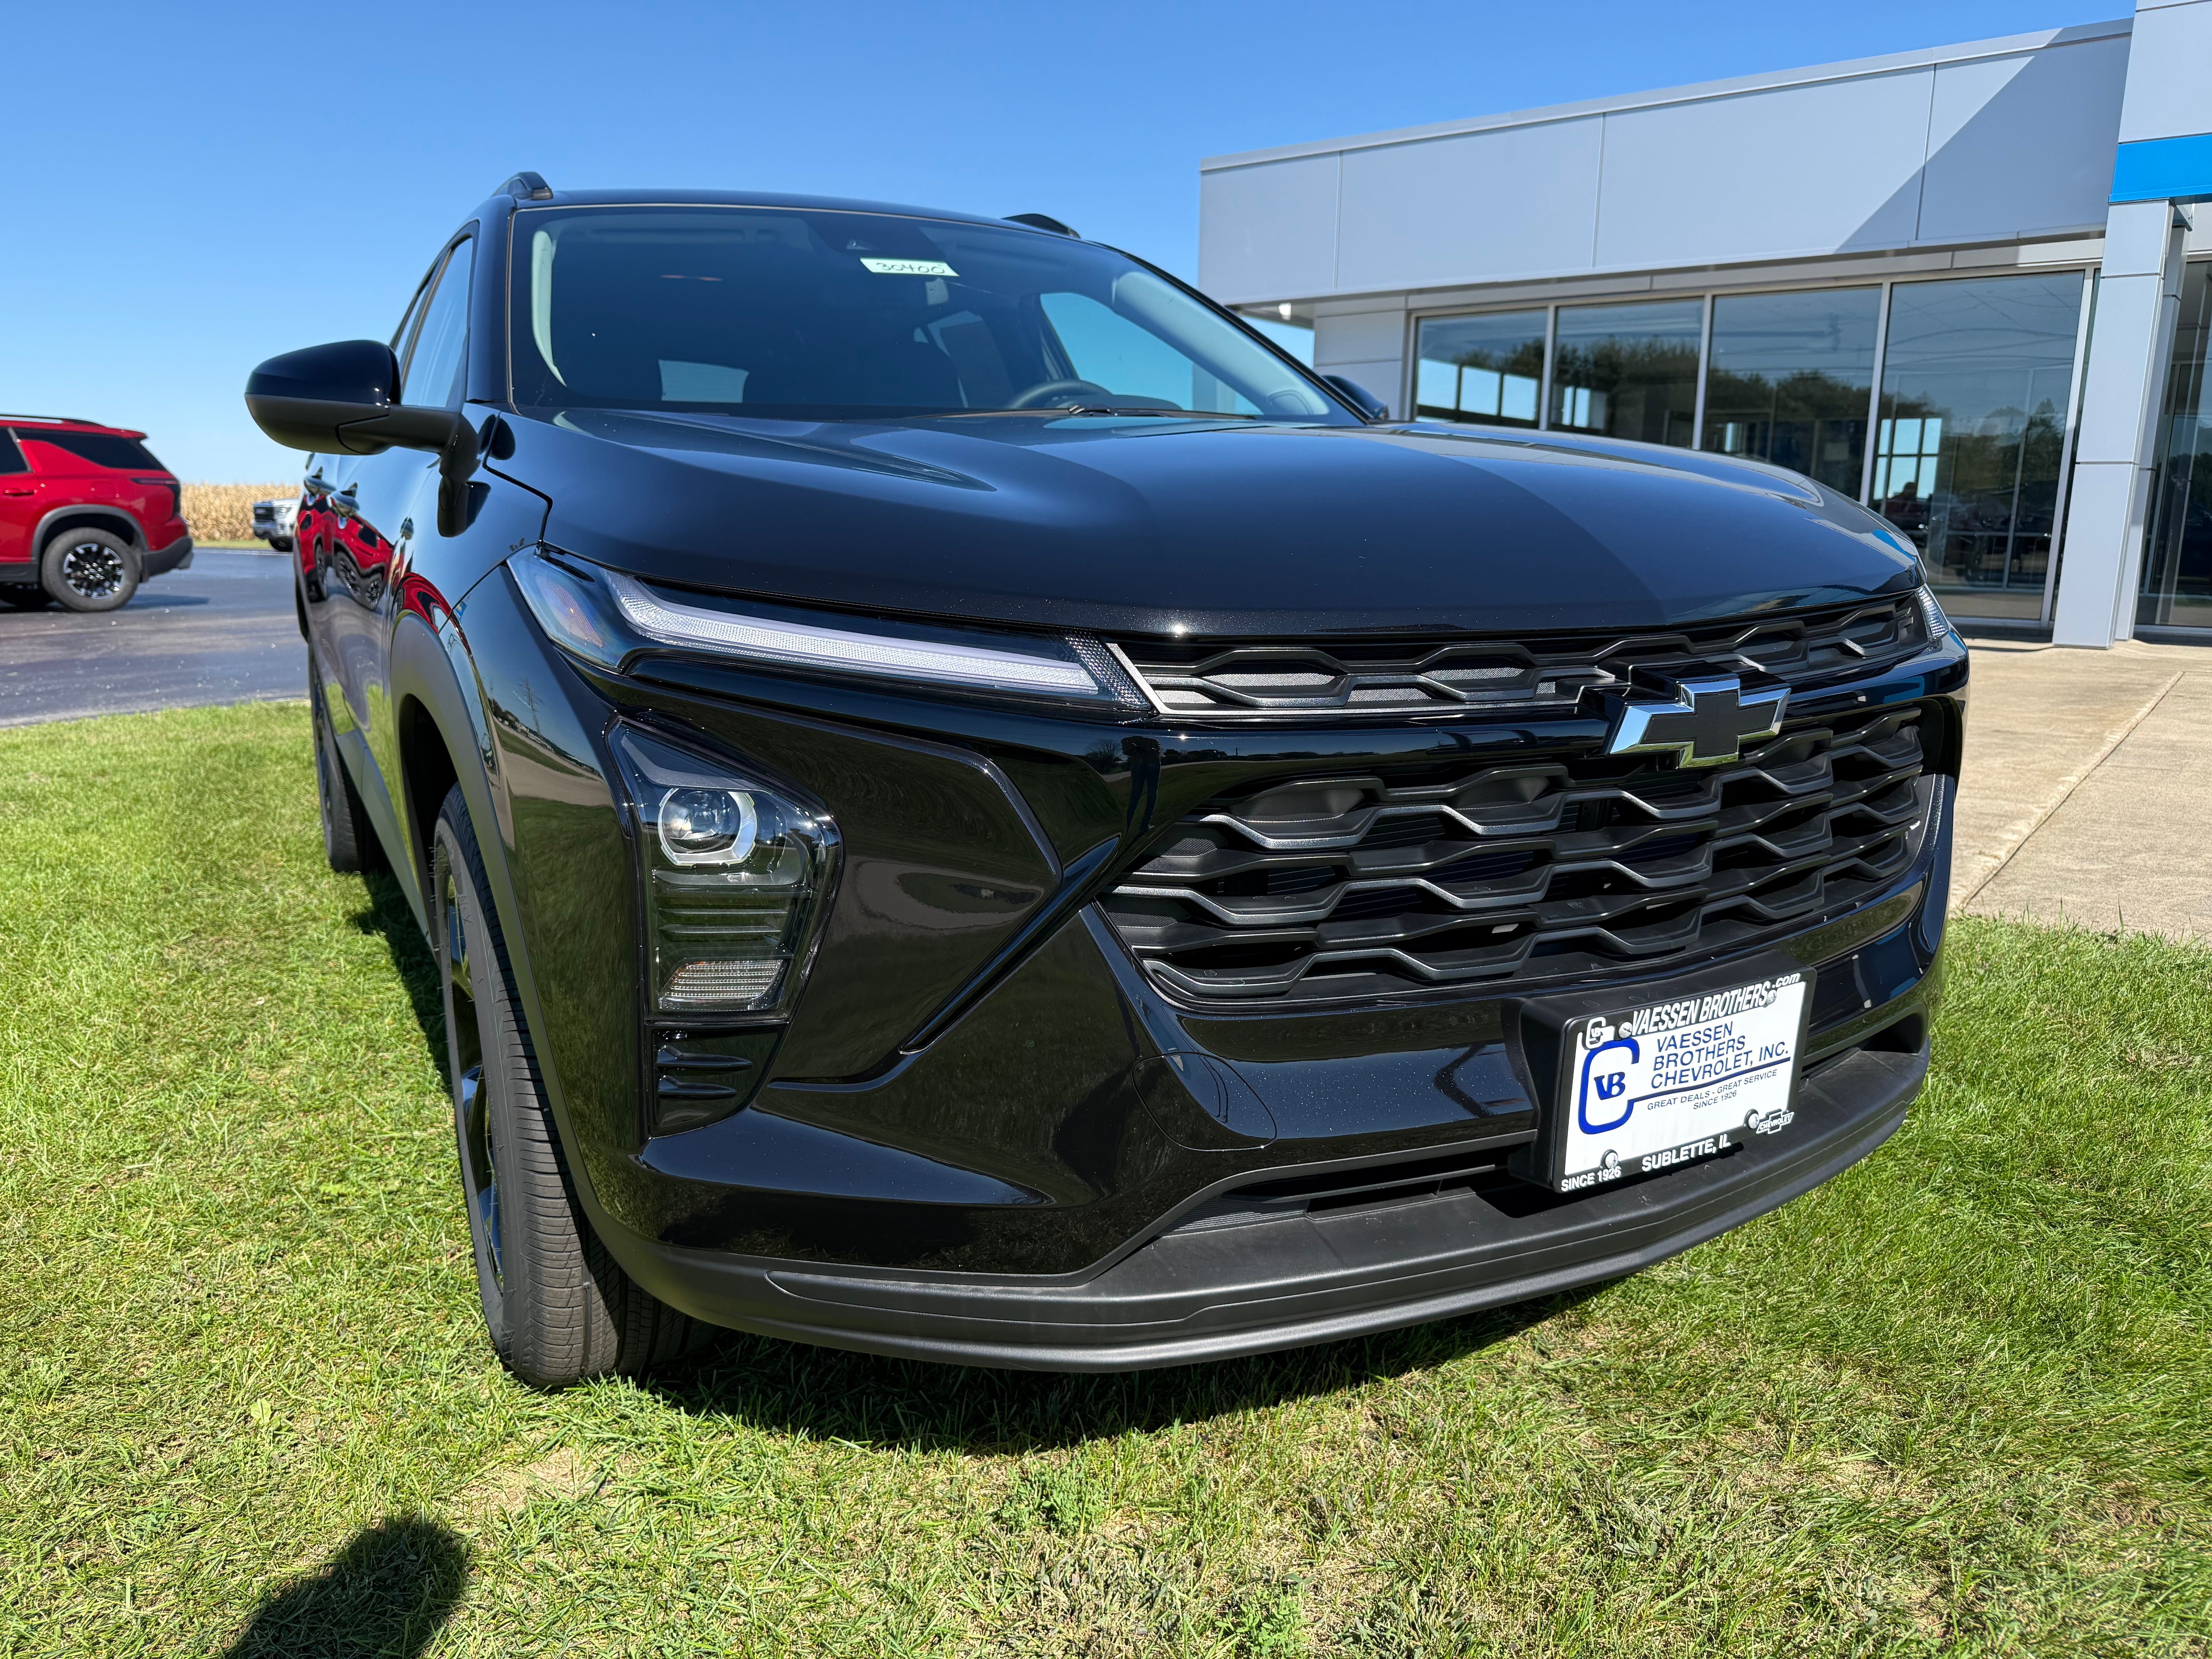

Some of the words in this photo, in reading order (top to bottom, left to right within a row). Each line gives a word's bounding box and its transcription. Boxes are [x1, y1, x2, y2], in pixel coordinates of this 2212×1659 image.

[1632, 998, 1700, 1036] VAESSEN
[1653, 1035, 1746, 1071] BROTHERS
[1657, 1020, 1733, 1053] VAESSEN
[1651, 1050, 1753, 1089] CHEVROLET,
[1759, 1041, 1789, 1062] INC.
[1593, 1071, 1626, 1101] VB
[1647, 1097, 1678, 1110] GREAT
[1680, 1091, 1710, 1103] DEALS
[1717, 1079, 1742, 1094] GREAT
[1744, 1069, 1778, 1085] SERVICE
[1693, 1096, 1718, 1109] SINCE
[1721, 1090, 1737, 1101] 1926
[1759, 1115, 1791, 1130] CHEVROLET
[1642, 1137, 1717, 1172] SUBLETTE,
[1718, 1133, 1732, 1149] IL
[1561, 1172, 1595, 1192] SINCE
[1597, 1165, 1622, 1183] 1926
